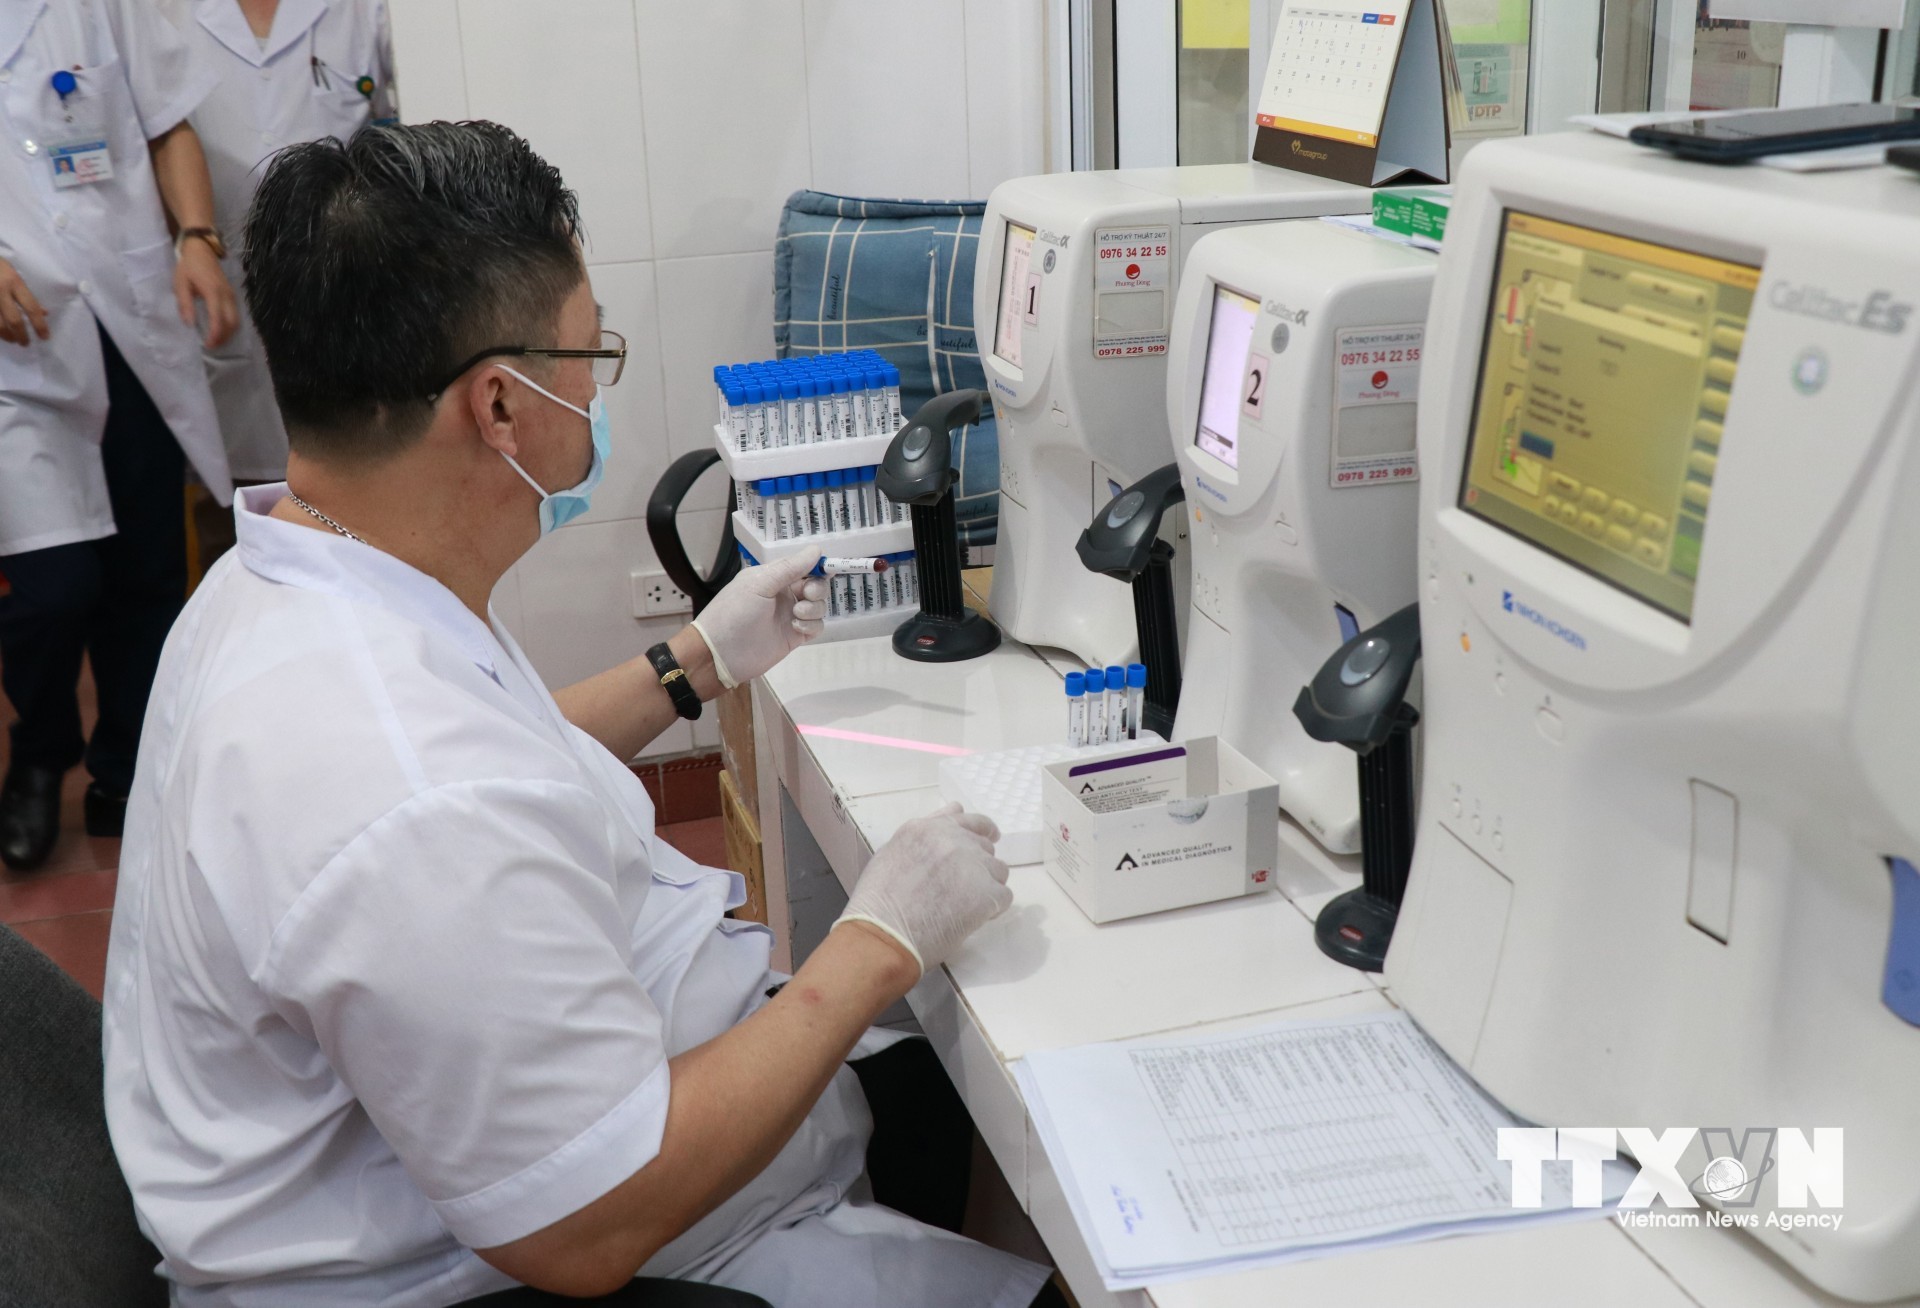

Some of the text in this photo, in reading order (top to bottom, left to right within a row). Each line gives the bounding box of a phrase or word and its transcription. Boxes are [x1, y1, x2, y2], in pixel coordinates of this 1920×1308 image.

[1100, 246, 1167, 259] 0976 34 22 55
[827, 274, 842, 320] beautiful
[1028, 285, 1036, 316] 1
[1099, 348, 1122, 356] 0978
[1148, 345, 1165, 353] 999
[1342, 349, 1420, 366] 0976 34 22 55
[1246, 369, 1262, 407] 2
[1338, 467, 1413, 482] 0978 225 999
[1142, 842, 1213, 860] ADVANCED QUALITY
[1151, 855, 1183, 866] MEDICAL
[1185, 846, 1233, 860] DIAGNOSTICS
